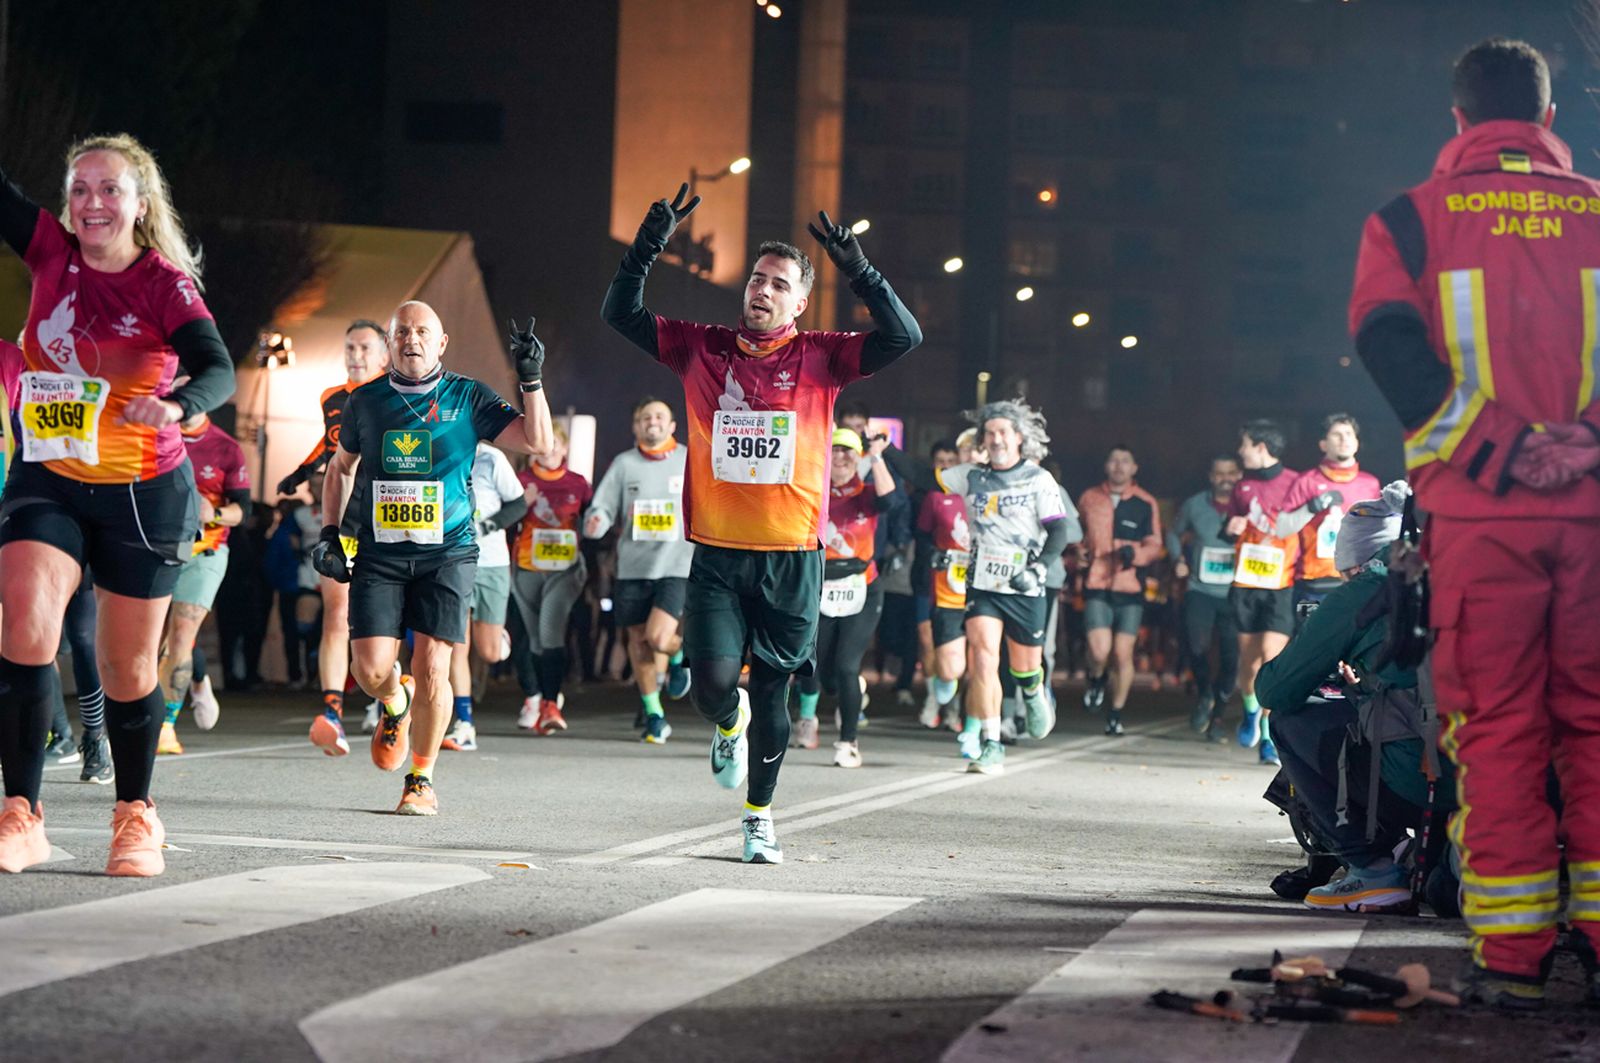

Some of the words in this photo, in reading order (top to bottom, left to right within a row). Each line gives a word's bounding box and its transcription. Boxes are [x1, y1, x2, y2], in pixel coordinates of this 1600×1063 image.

[1446, 191, 1600, 215] BOMBEROS
[1490, 214, 1562, 239] JAÉN
[47, 337, 73, 365] 43
[35, 402, 85, 430] 3969
[732, 418, 756, 427] NOCHE
[757, 418, 765, 427] DE
[721, 426, 737, 435] SAN
[727, 436, 781, 459] 3962
[387, 487, 407, 495] NOCHE
[381, 503, 434, 523] 13868
[985, 562, 1016, 578] 4207
[827, 590, 854, 602] 4710
